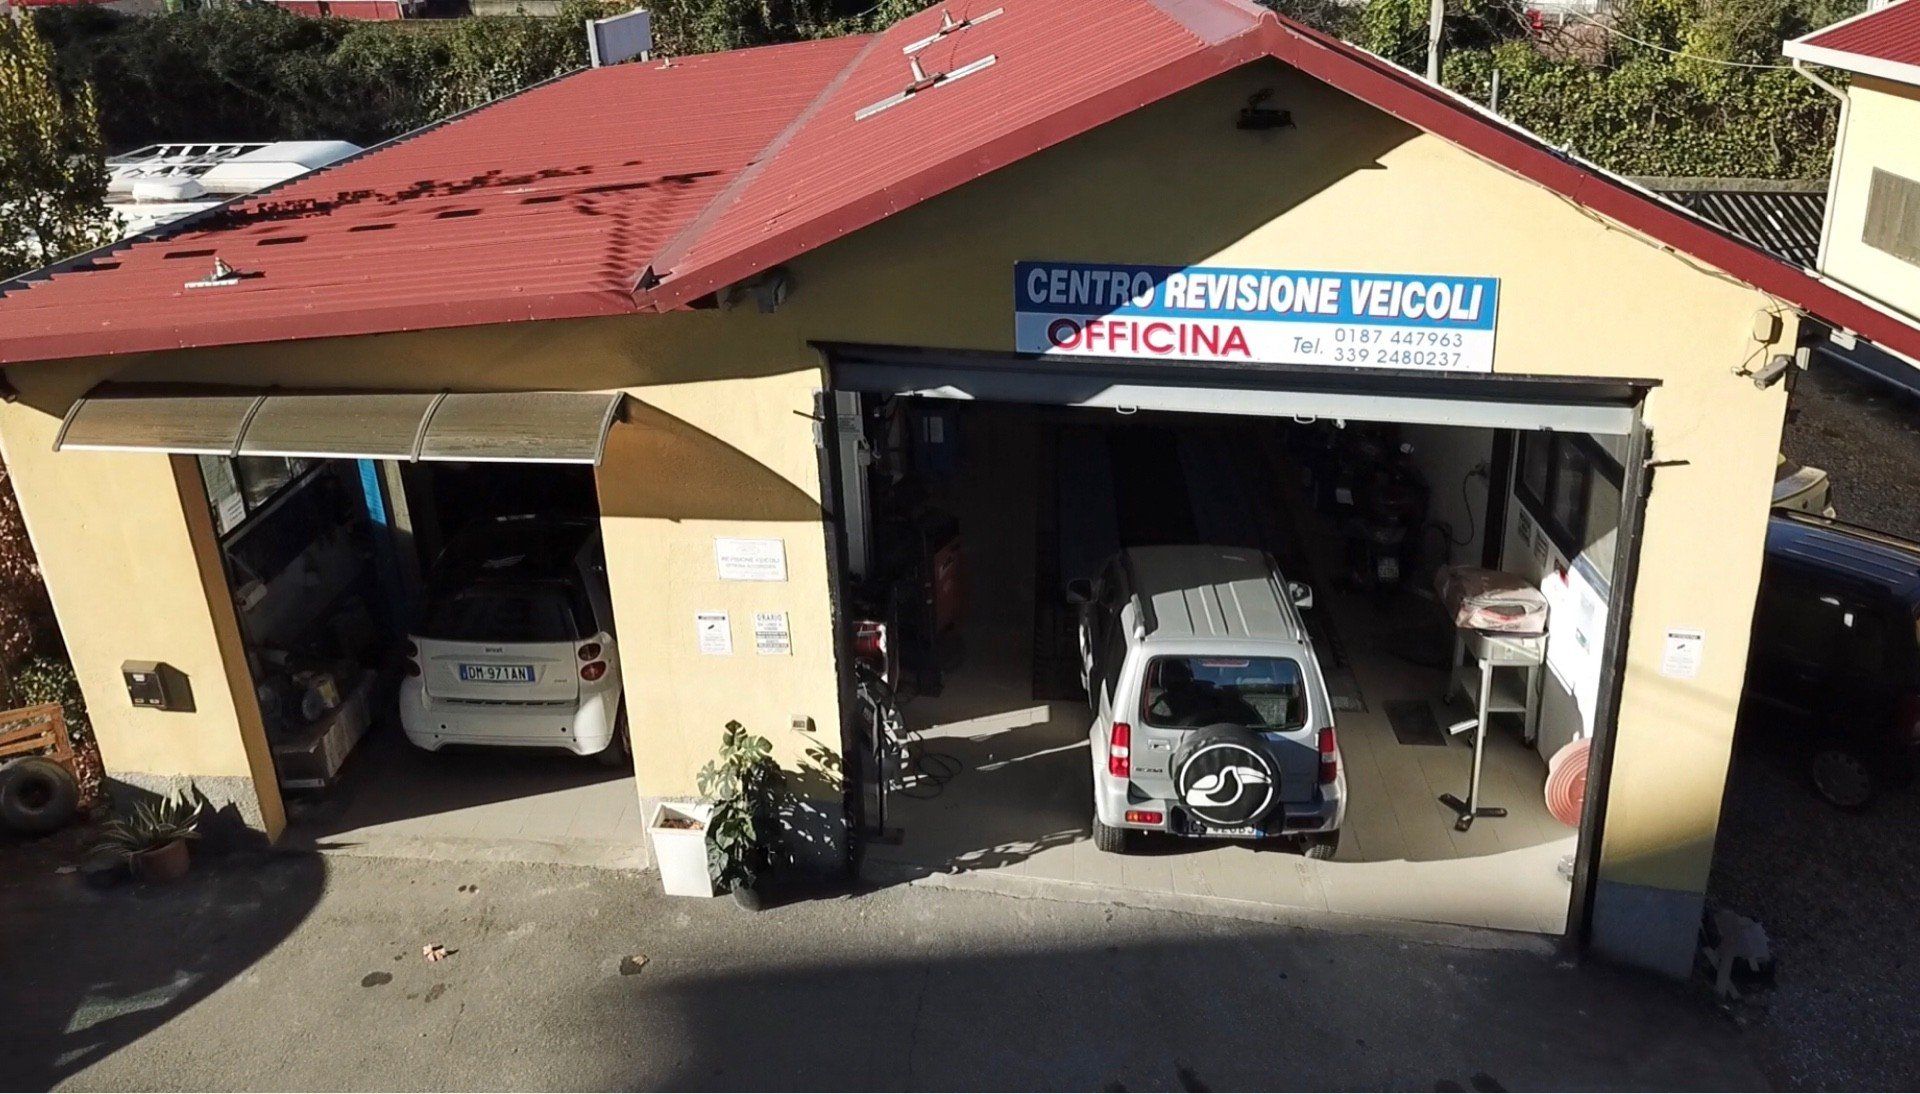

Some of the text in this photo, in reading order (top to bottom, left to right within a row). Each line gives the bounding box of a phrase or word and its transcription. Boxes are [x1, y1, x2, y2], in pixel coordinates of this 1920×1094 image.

[1027, 267, 1484, 321] CENTRO REVISIONE VEICOLI
[1047, 316, 1252, 358] OFFICINA
[1293, 335, 1324, 355] Tel.
[1334, 327, 1464, 348] 0187 447963
[1333, 346, 1462, 367] 339 2480237
[468, 666, 526, 680] DM 971AN
